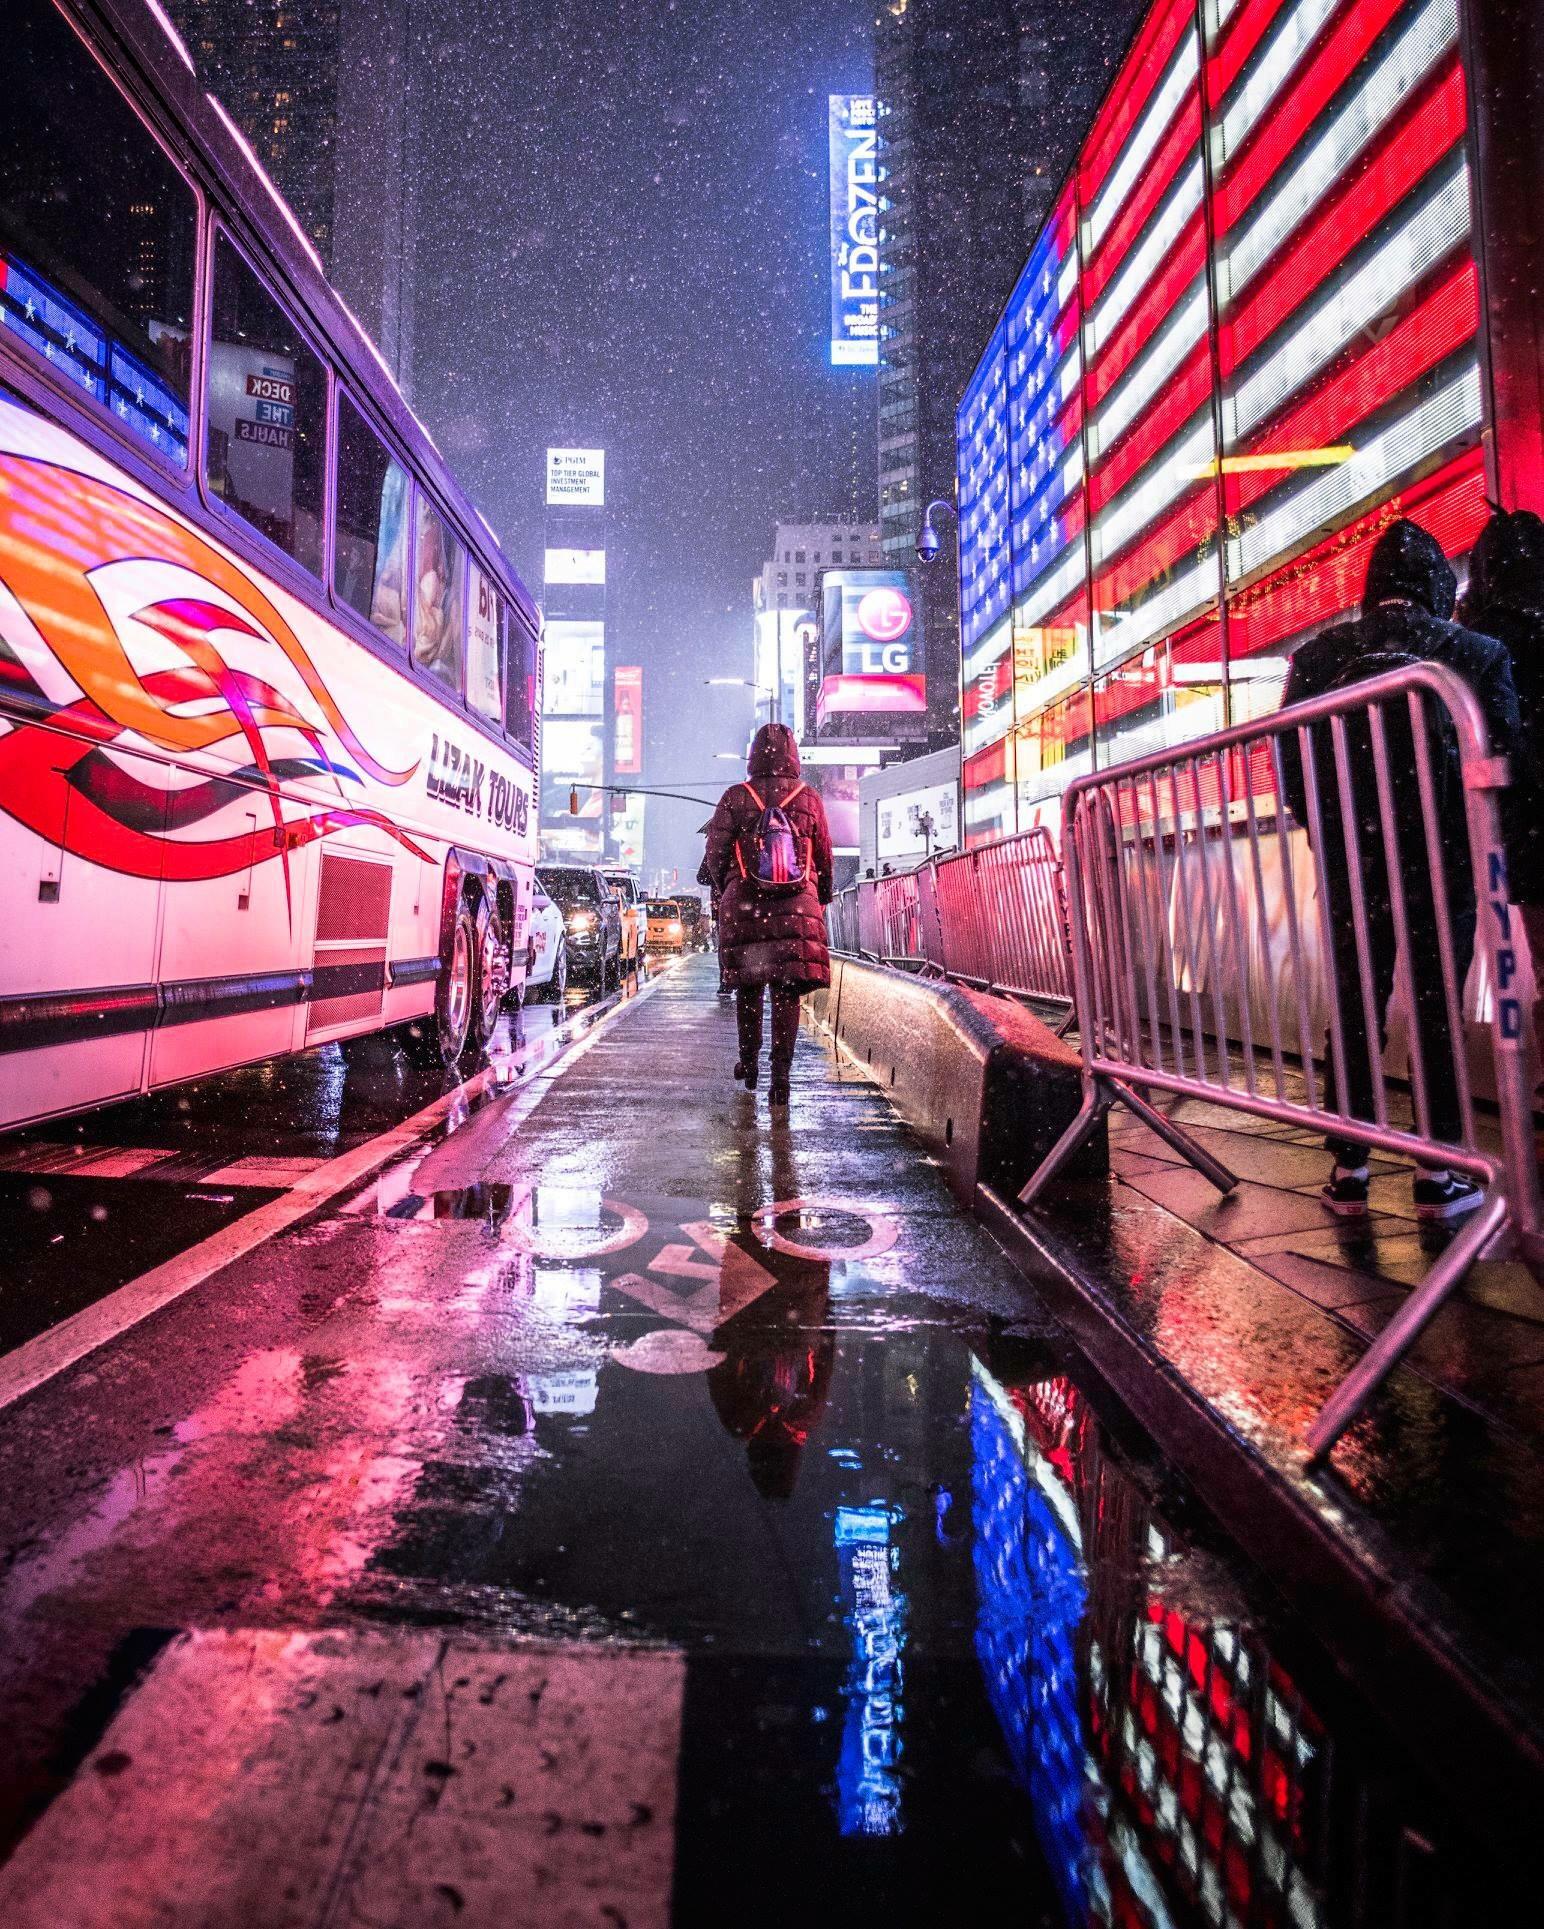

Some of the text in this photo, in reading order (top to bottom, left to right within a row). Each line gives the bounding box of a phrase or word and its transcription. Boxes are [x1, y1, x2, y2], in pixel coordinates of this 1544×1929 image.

[550, 478, 587, 486] INVESTMENT
[551, 469, 600, 478] TOP TIER GLOBAL
[550, 486, 591, 494] MANAGEMENT
[861, 643, 909, 673] LG
[426, 732, 529, 838] LIZAK TOURS
[1487, 851, 1520, 1039] NYPD
